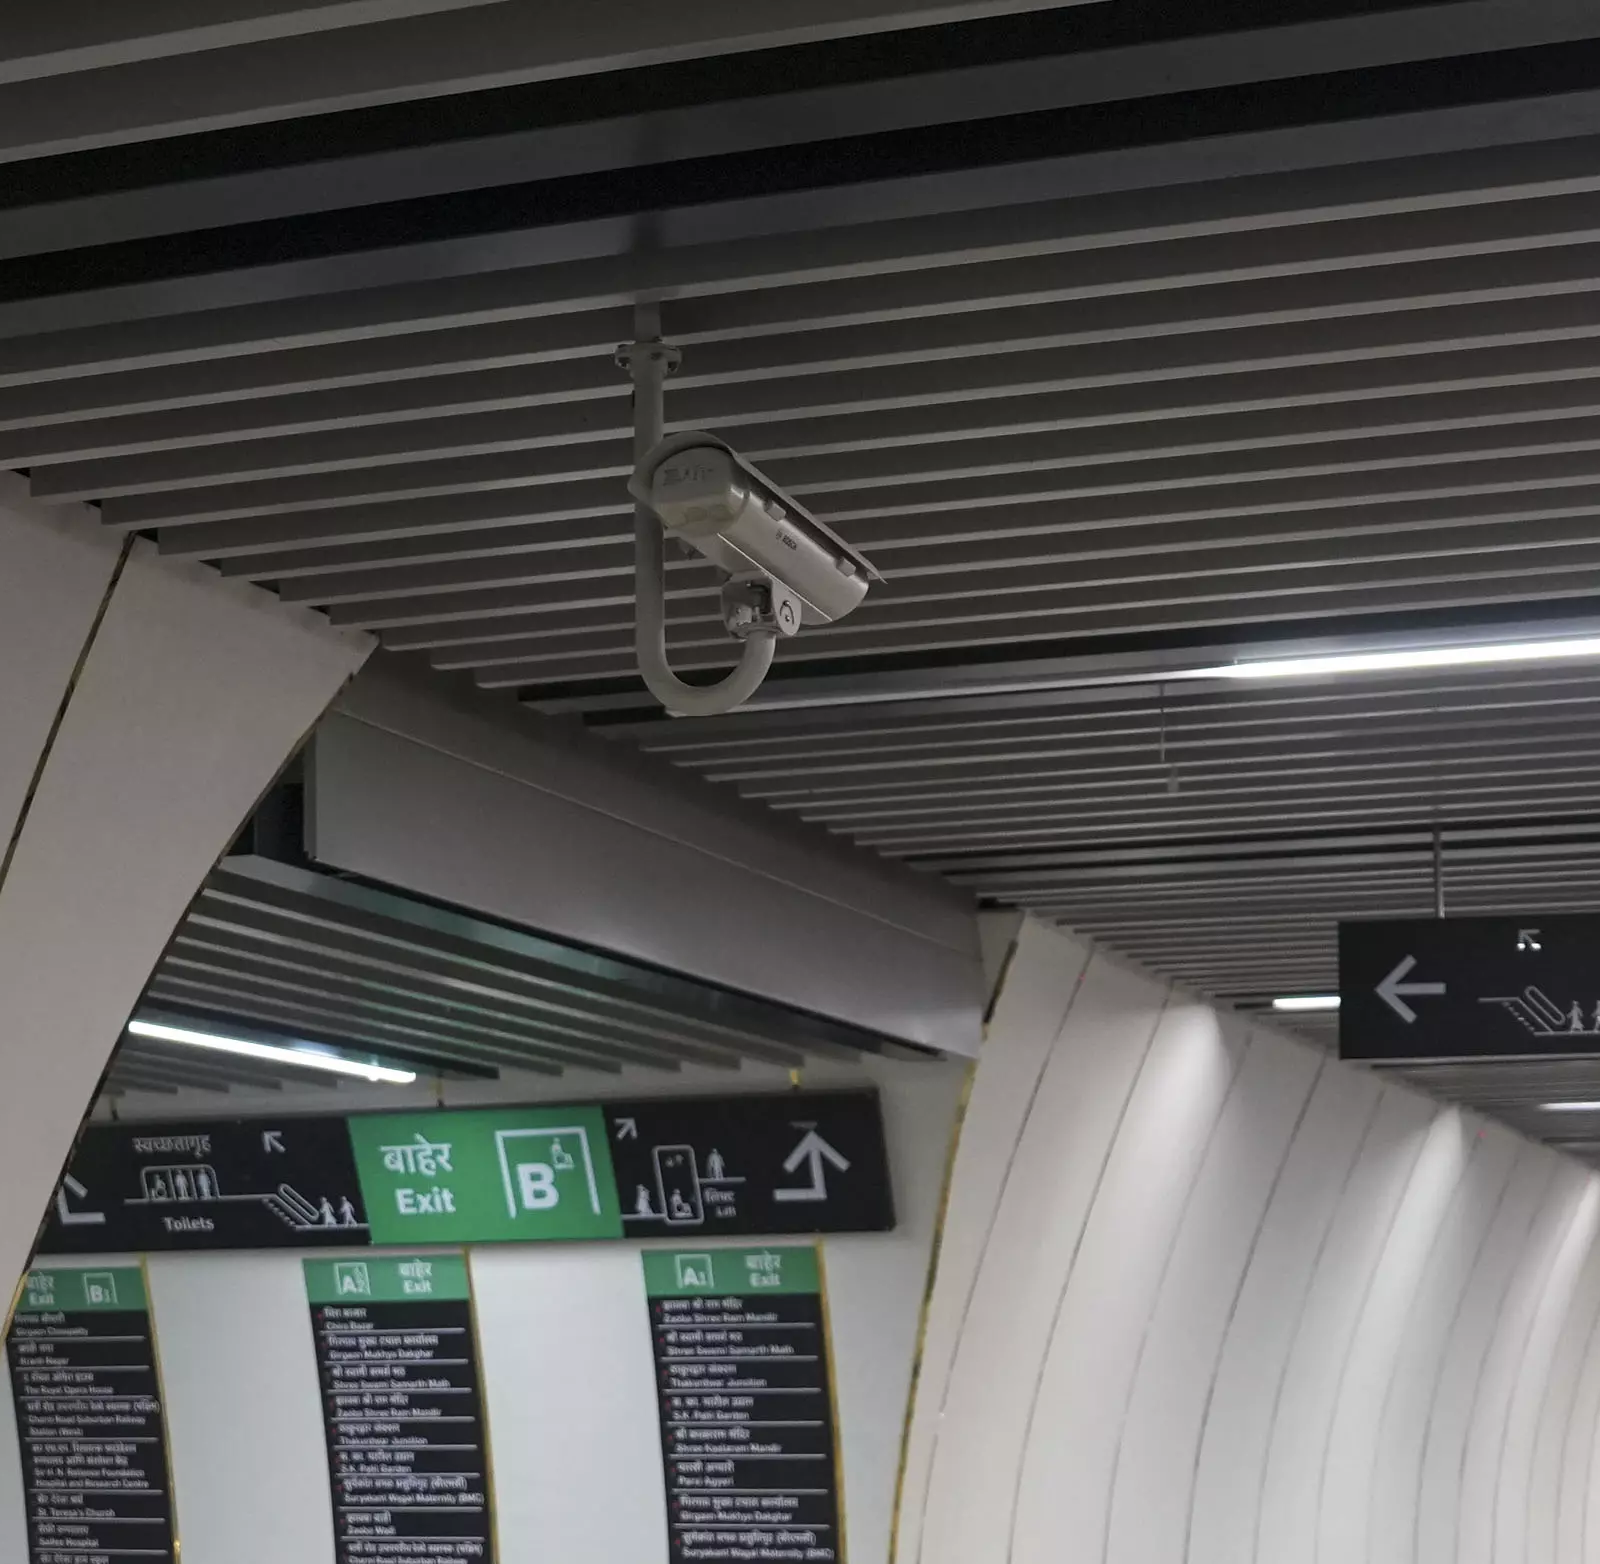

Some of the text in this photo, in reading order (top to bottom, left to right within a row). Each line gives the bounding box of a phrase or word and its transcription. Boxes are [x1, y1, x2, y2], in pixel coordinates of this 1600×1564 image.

[380, 1133, 453, 1177] बाहेर
[395, 1187, 456, 1215] Exit
[162, 1217, 215, 1232] Toilets
[403, 1280, 433, 1294] Exit
[750, 1273, 780, 1287] Exit
